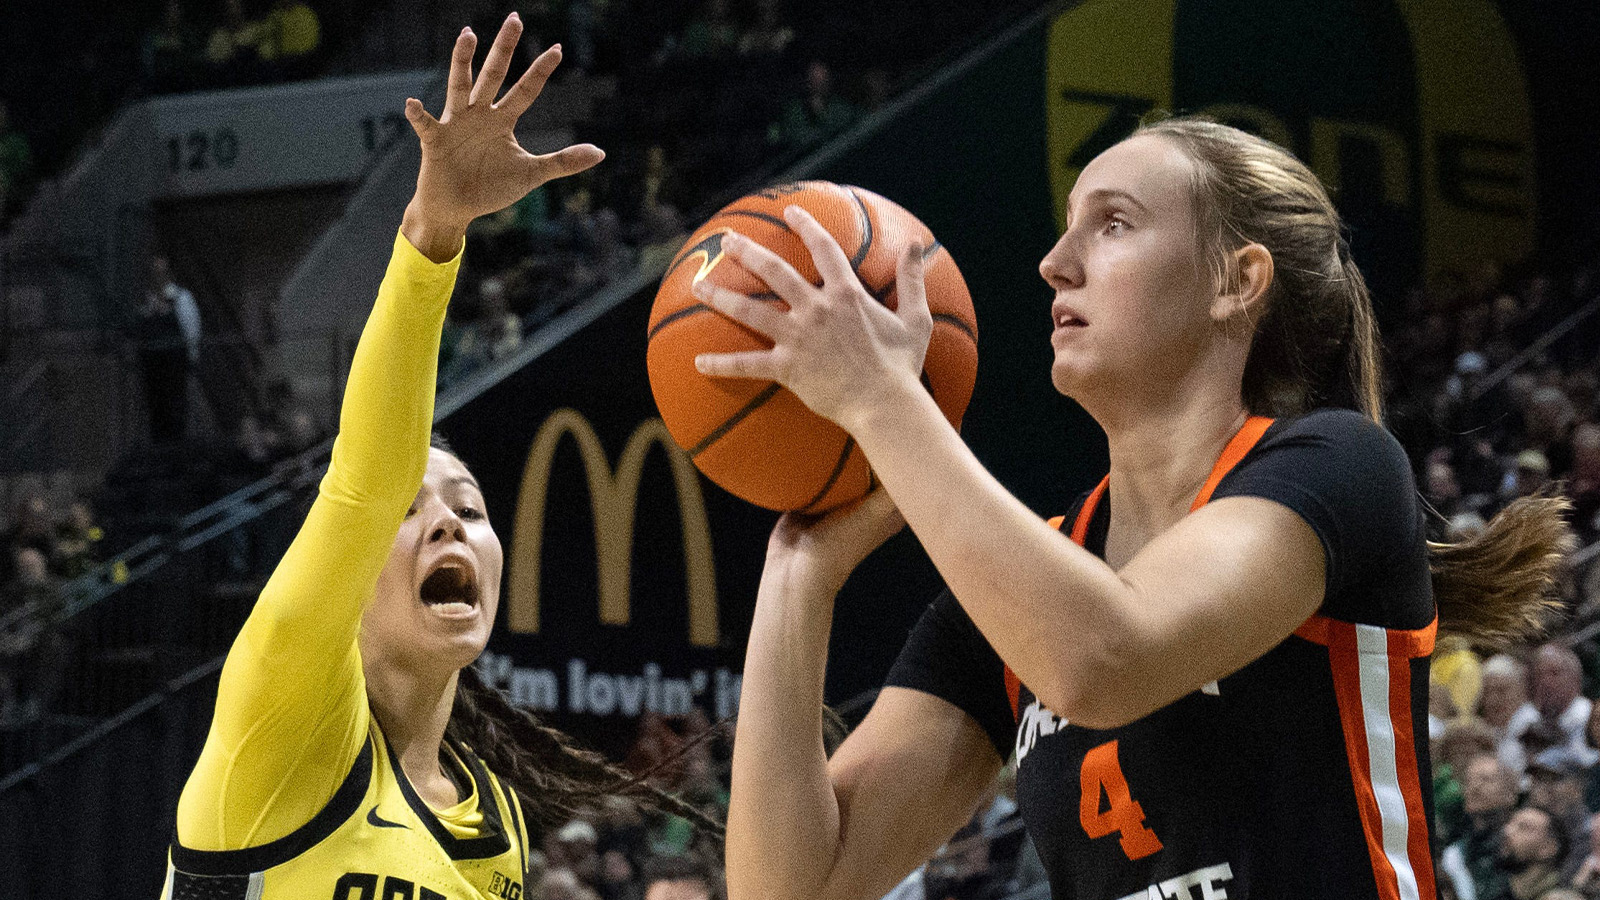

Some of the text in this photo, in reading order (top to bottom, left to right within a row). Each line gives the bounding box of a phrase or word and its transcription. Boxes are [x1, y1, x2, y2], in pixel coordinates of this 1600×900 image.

[167, 128, 238, 172] 120
[567, 657, 708, 717] lovin'
[1079, 739, 1164, 861] 4
